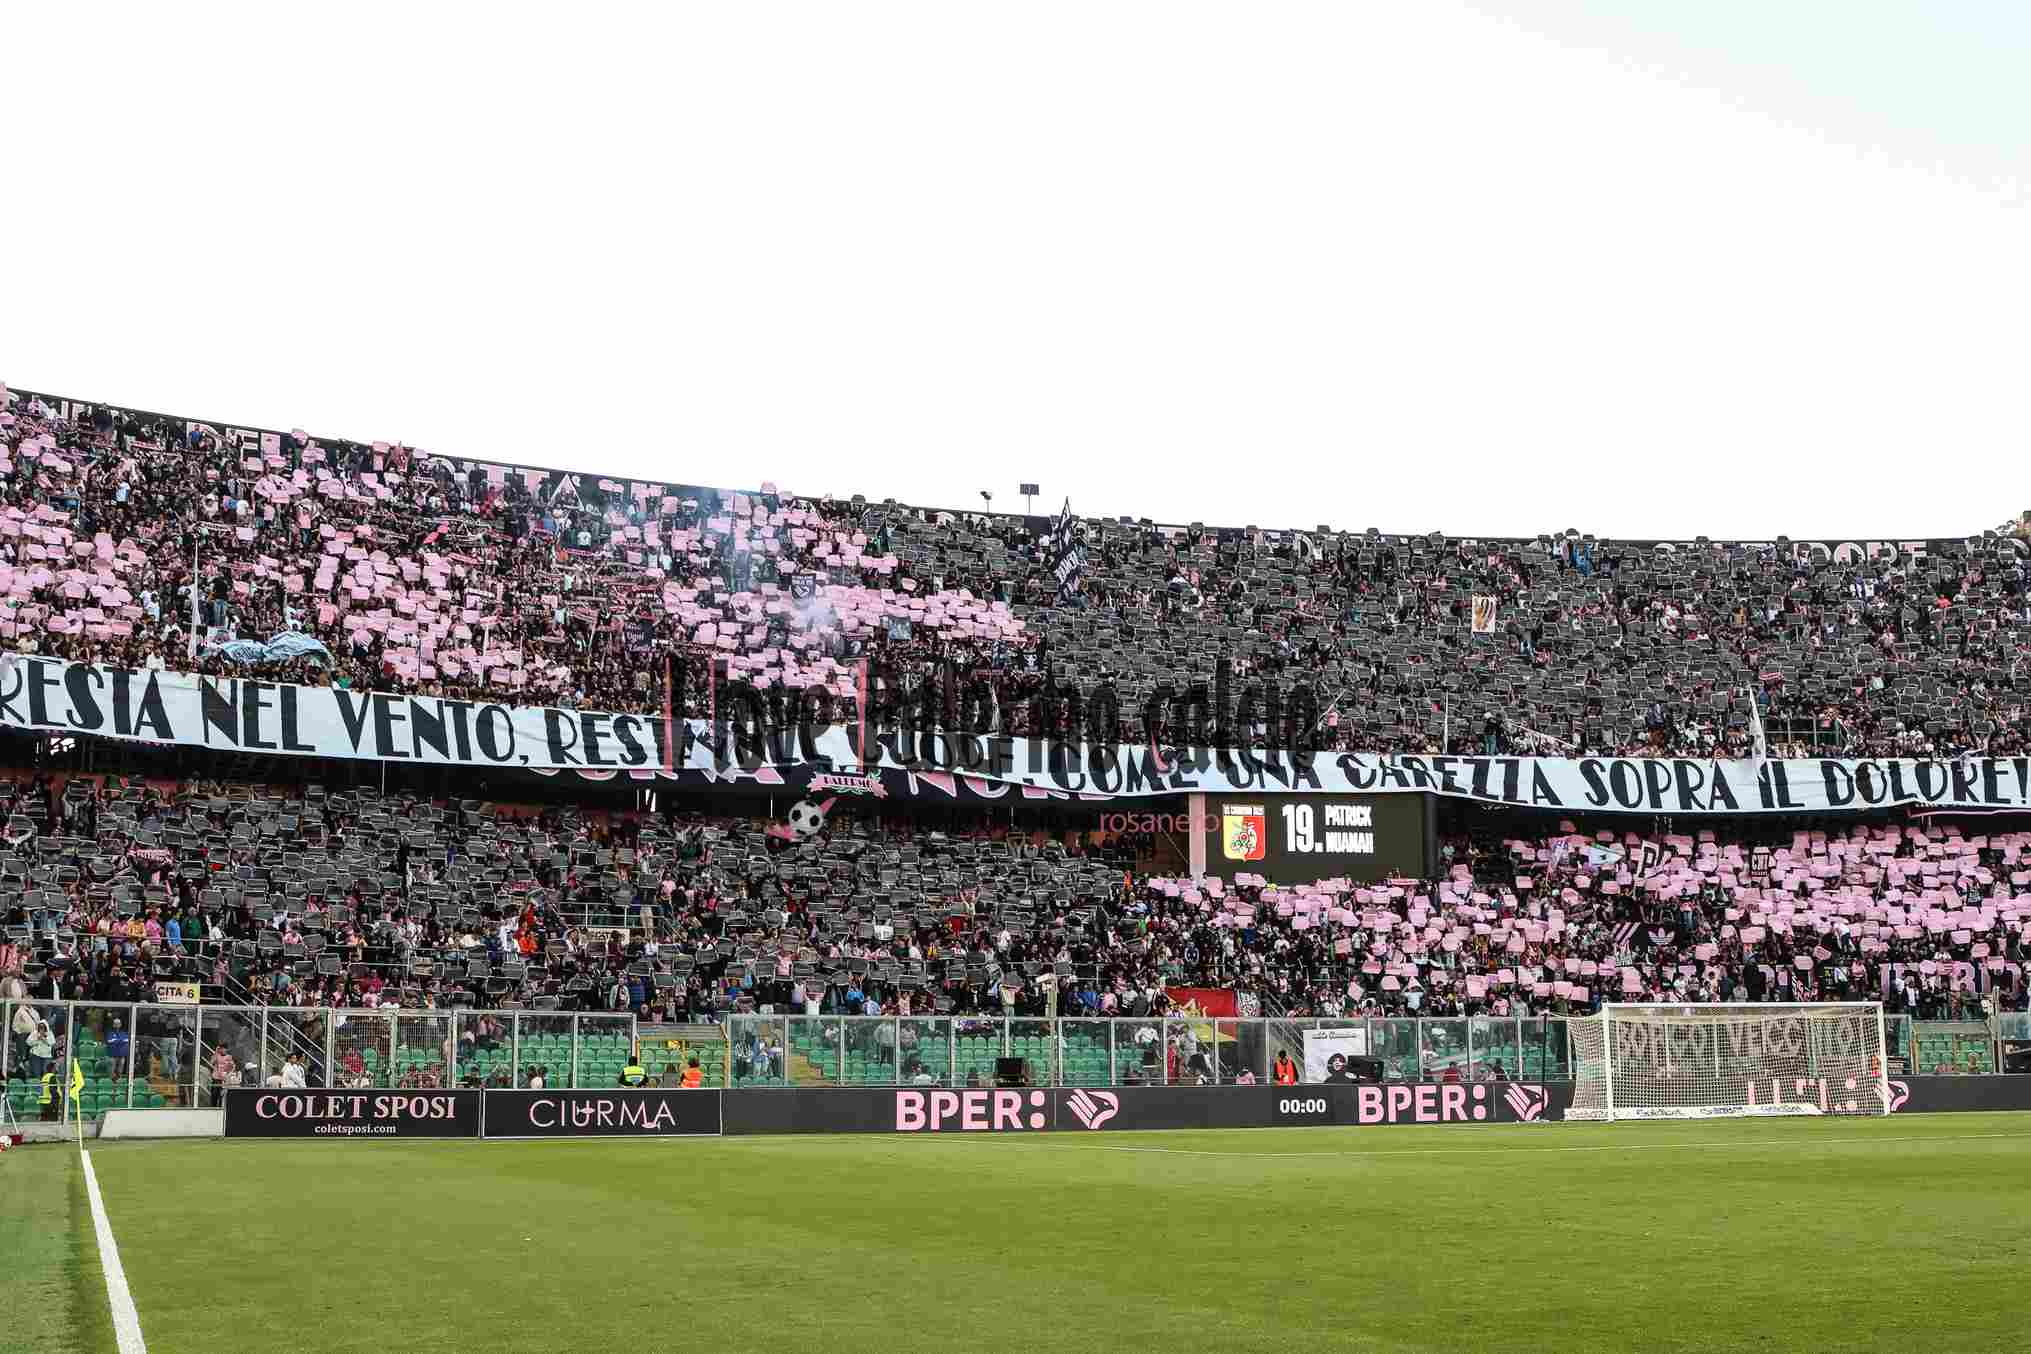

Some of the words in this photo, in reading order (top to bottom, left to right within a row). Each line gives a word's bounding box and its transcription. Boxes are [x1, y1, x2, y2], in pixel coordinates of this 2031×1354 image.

[0, 657, 176, 739] RESTA
[200, 676, 315, 751] NEL
[331, 686, 528, 767] VENTO,
[1336, 753, 1563, 806] CAREZZA
[1578, 759, 1740, 811] SOPRA
[1756, 760, 1805, 808] IL
[1820, 758, 2030, 805] DOLORE!
[1325, 805, 1372, 827] PATRICK
[255, 1094, 366, 1119] COLET
[374, 1095, 456, 1119] SPOSI
[529, 1099, 676, 1129] CIURMA
[1279, 1099, 1327, 1114] 00:00
[314, 1123, 397, 1136] coletsposi.com
